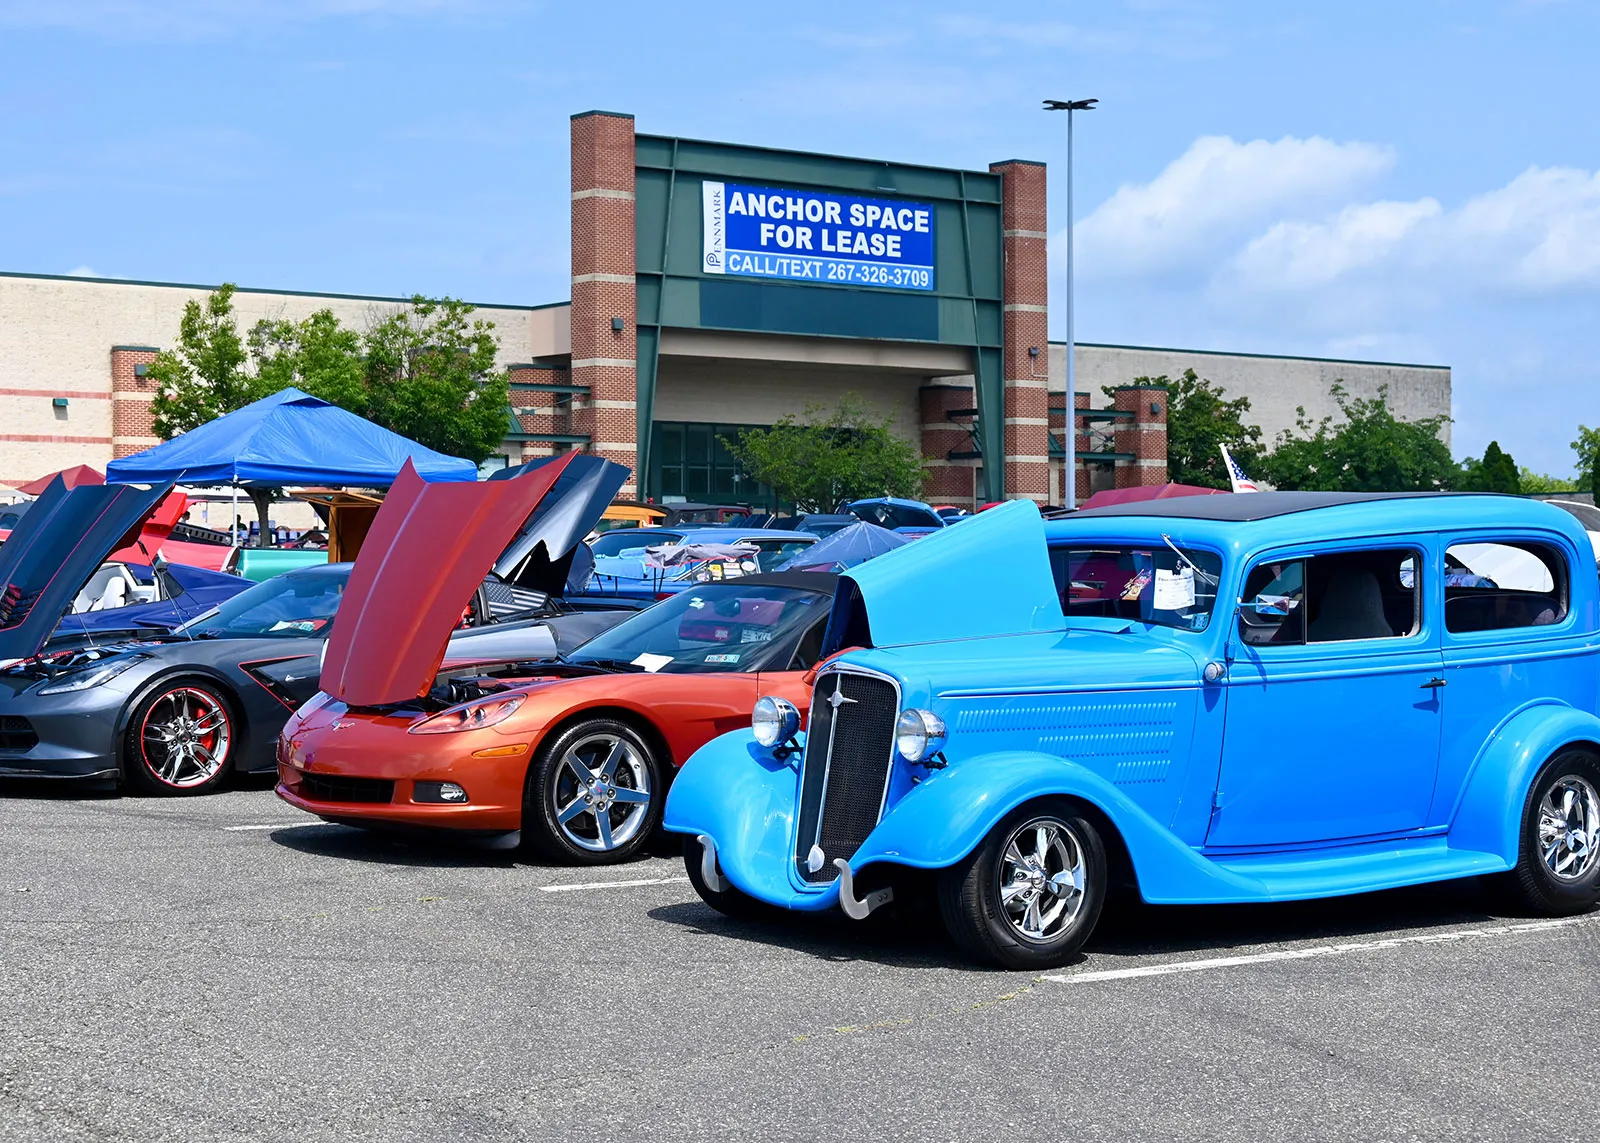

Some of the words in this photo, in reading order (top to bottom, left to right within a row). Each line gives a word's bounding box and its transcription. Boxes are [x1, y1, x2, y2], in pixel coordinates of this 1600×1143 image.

[706, 191, 721, 267] PENNMARK
[728, 192, 842, 224] ANCHOR
[850, 204, 929, 233] SPACE
[760, 223, 813, 250] FOR
[821, 229, 902, 258] LEASE
[729, 254, 823, 279] CALL/TEXT
[828, 263, 929, 287] 267-326-3709
